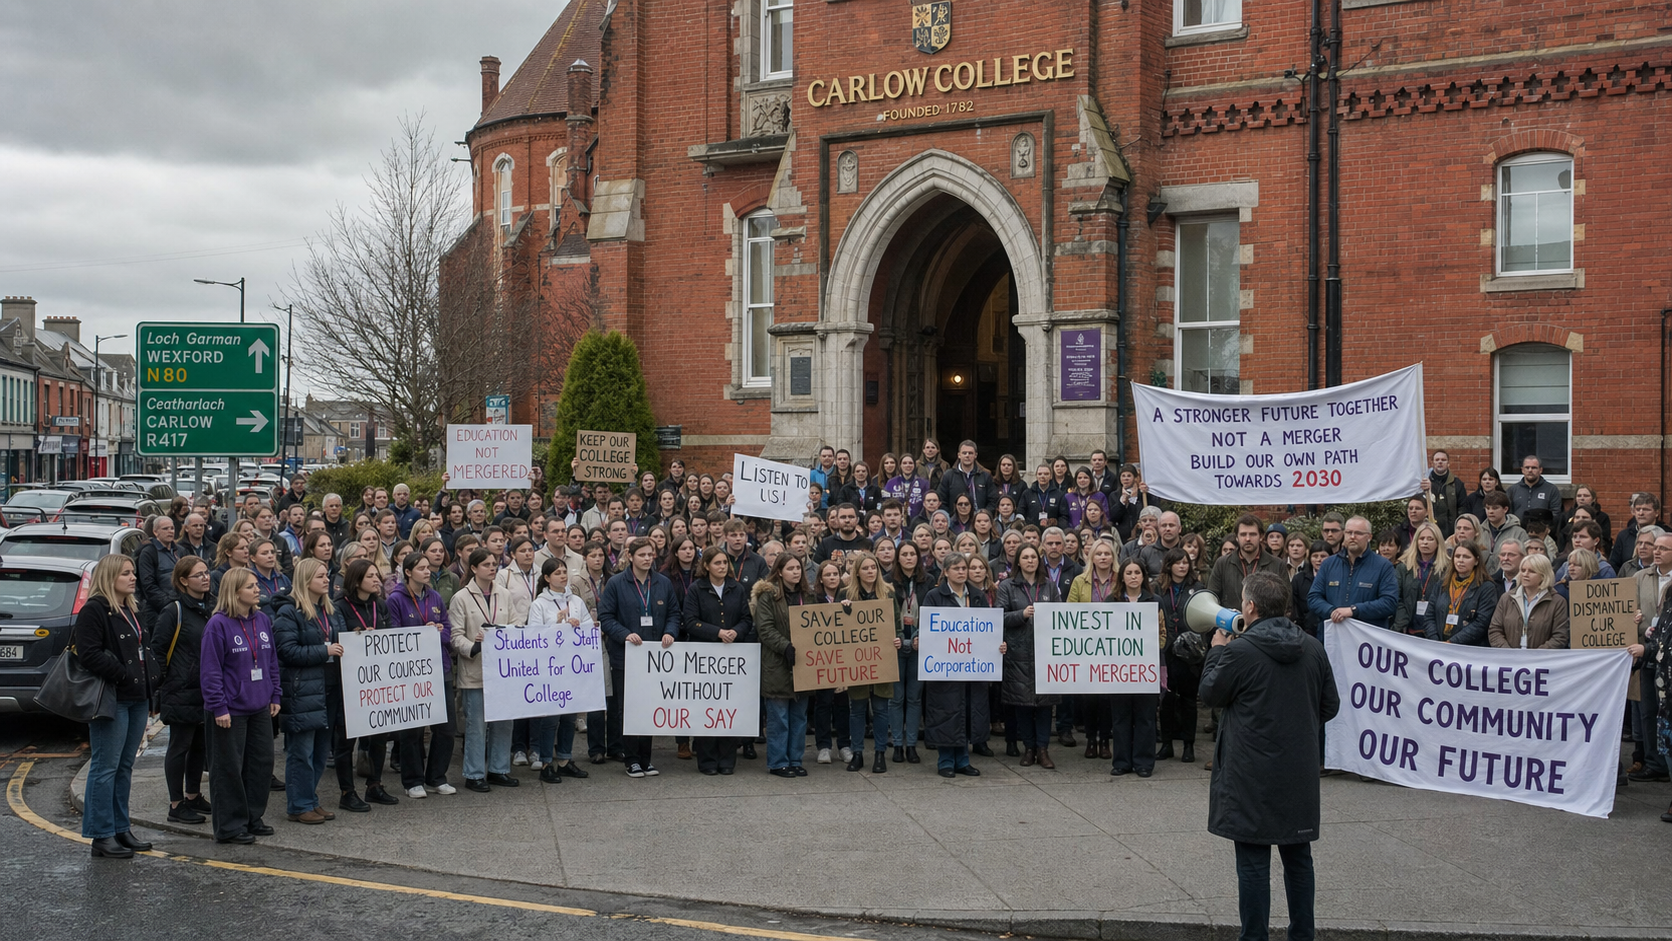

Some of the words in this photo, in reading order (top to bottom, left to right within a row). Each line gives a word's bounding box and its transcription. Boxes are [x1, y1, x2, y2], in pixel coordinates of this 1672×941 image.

[807, 66, 930, 107] CARLOW
[934, 48, 1075, 92] COLLEGE
[883, 104, 940, 121] FOUNDED
[945, 100, 974, 114] 1782
[147, 332, 179, 345] Loch
[187, 333, 241, 345] Garman
[147, 350, 223, 363] WEXFORD
[147, 397, 225, 410] Ceatharlach
[1153, 407, 1163, 423] A
[1174, 408, 1251, 423] STRONGER
[1261, 405, 1319, 422] FUTURE
[1327, 395, 1398, 417] TOGETHER
[146, 416, 213, 428] CARLOW
[147, 433, 188, 447] R417
[457, 429, 518, 441] EDUCATION
[580, 434, 605, 446] KEEP
[610, 436, 629, 448] OUR
[1212, 432, 1247, 447] NOT
[1260, 432, 1272, 446] A
[1283, 427, 1342, 445] MERGER
[475, 447, 499, 458] NOT
[580, 448, 630, 463] COLLEGE
[1191, 454, 1235, 470] BUILD
[1245, 453, 1274, 468] OUR
[1283, 452, 1315, 467] OWN
[1324, 449, 1358, 464] PATH
[453, 464, 528, 479] MERGERED
[584, 465, 627, 479] STRONG
[795, 474, 808, 489] TO
[1214, 473, 1282, 489] TOWARDS
[1292, 469, 1342, 488] 2030
[1586, 581, 1619, 599] DON'T
[800, 610, 844, 629] SAVE
[857, 608, 885, 624] OUR
[1574, 600, 1634, 617] DISMANTLE
[1052, 610, 1113, 631] INVEST
[1126, 612, 1142, 630] IN
[364, 632, 421, 657] PROTECT
[494, 630, 549, 651] Students
[555, 630, 565, 646] &
[813, 627, 878, 646] COLLEGE
[947, 637, 973, 654] Not
[1582, 632, 1626, 647] COLLEGE
[805, 649, 845, 667] SAVE
[854, 646, 882, 662] OUR
[1051, 637, 1144, 657] EDUCATION
[358, 664, 381, 684] OUR
[388, 658, 433, 679] COURSES
[498, 658, 539, 679] United
[548, 656, 565, 677] for
[571, 654, 596, 674] Our
[647, 650, 674, 673] NO
[924, 655, 995, 677] Corporation
[1357, 642, 1409, 679] OUR
[1427, 658, 1550, 697] COLLEGE
[816, 664, 879, 685] FUTURE
[1047, 663, 1080, 683] NOT
[1089, 663, 1157, 683] MERGERS
[359, 684, 406, 707] PROTECT
[413, 681, 434, 698] OUR
[524, 683, 573, 708] College
[660, 681, 733, 700] WITHOUT
[369, 703, 432, 729] COMMUNITY
[653, 707, 691, 729] OUR
[704, 707, 737, 729] SAY
[1350, 682, 1401, 719] OUR
[1417, 697, 1599, 743] COMMUNITY
[1358, 729, 1419, 772] OUR
[1437, 745, 1567, 795] FUTURE
